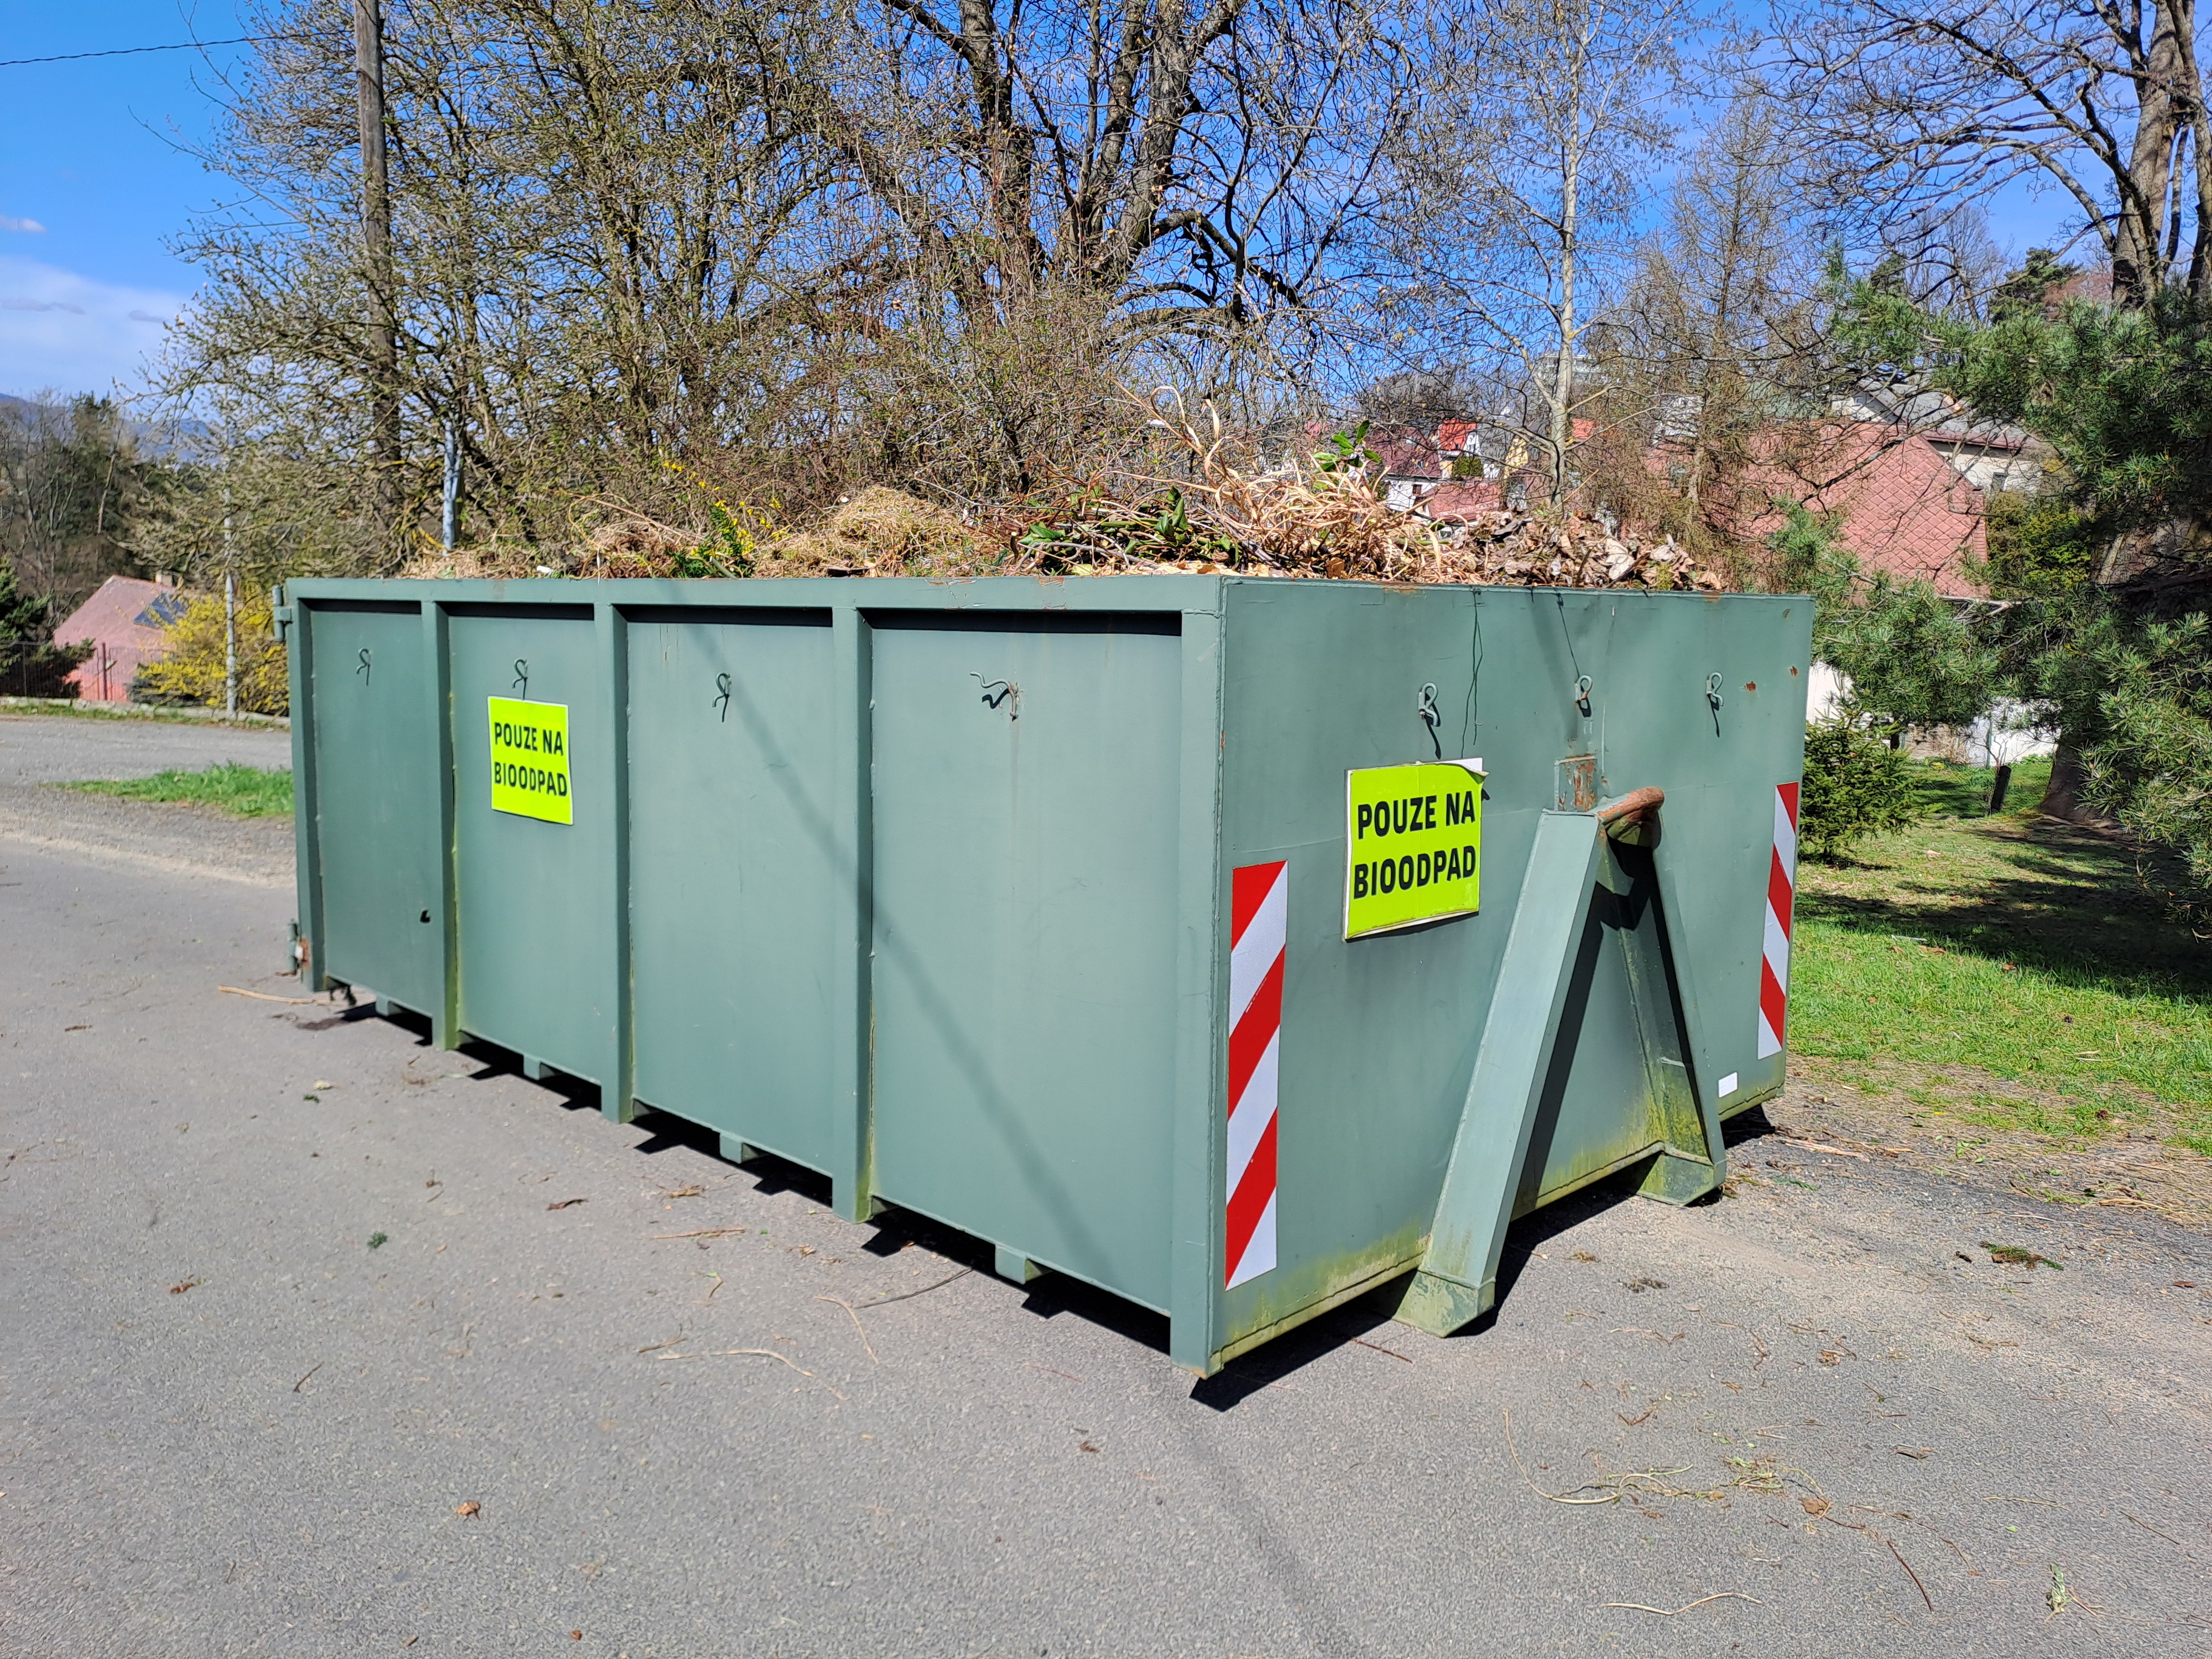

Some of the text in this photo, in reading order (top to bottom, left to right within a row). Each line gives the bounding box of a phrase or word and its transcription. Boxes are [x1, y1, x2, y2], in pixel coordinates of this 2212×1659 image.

[494, 722, 564, 757] POUZE NA
[494, 761, 567, 797] BIOODPAD
[1358, 791, 1475, 840] POUZE NA
[1354, 845, 1476, 899] BIOODPAD
